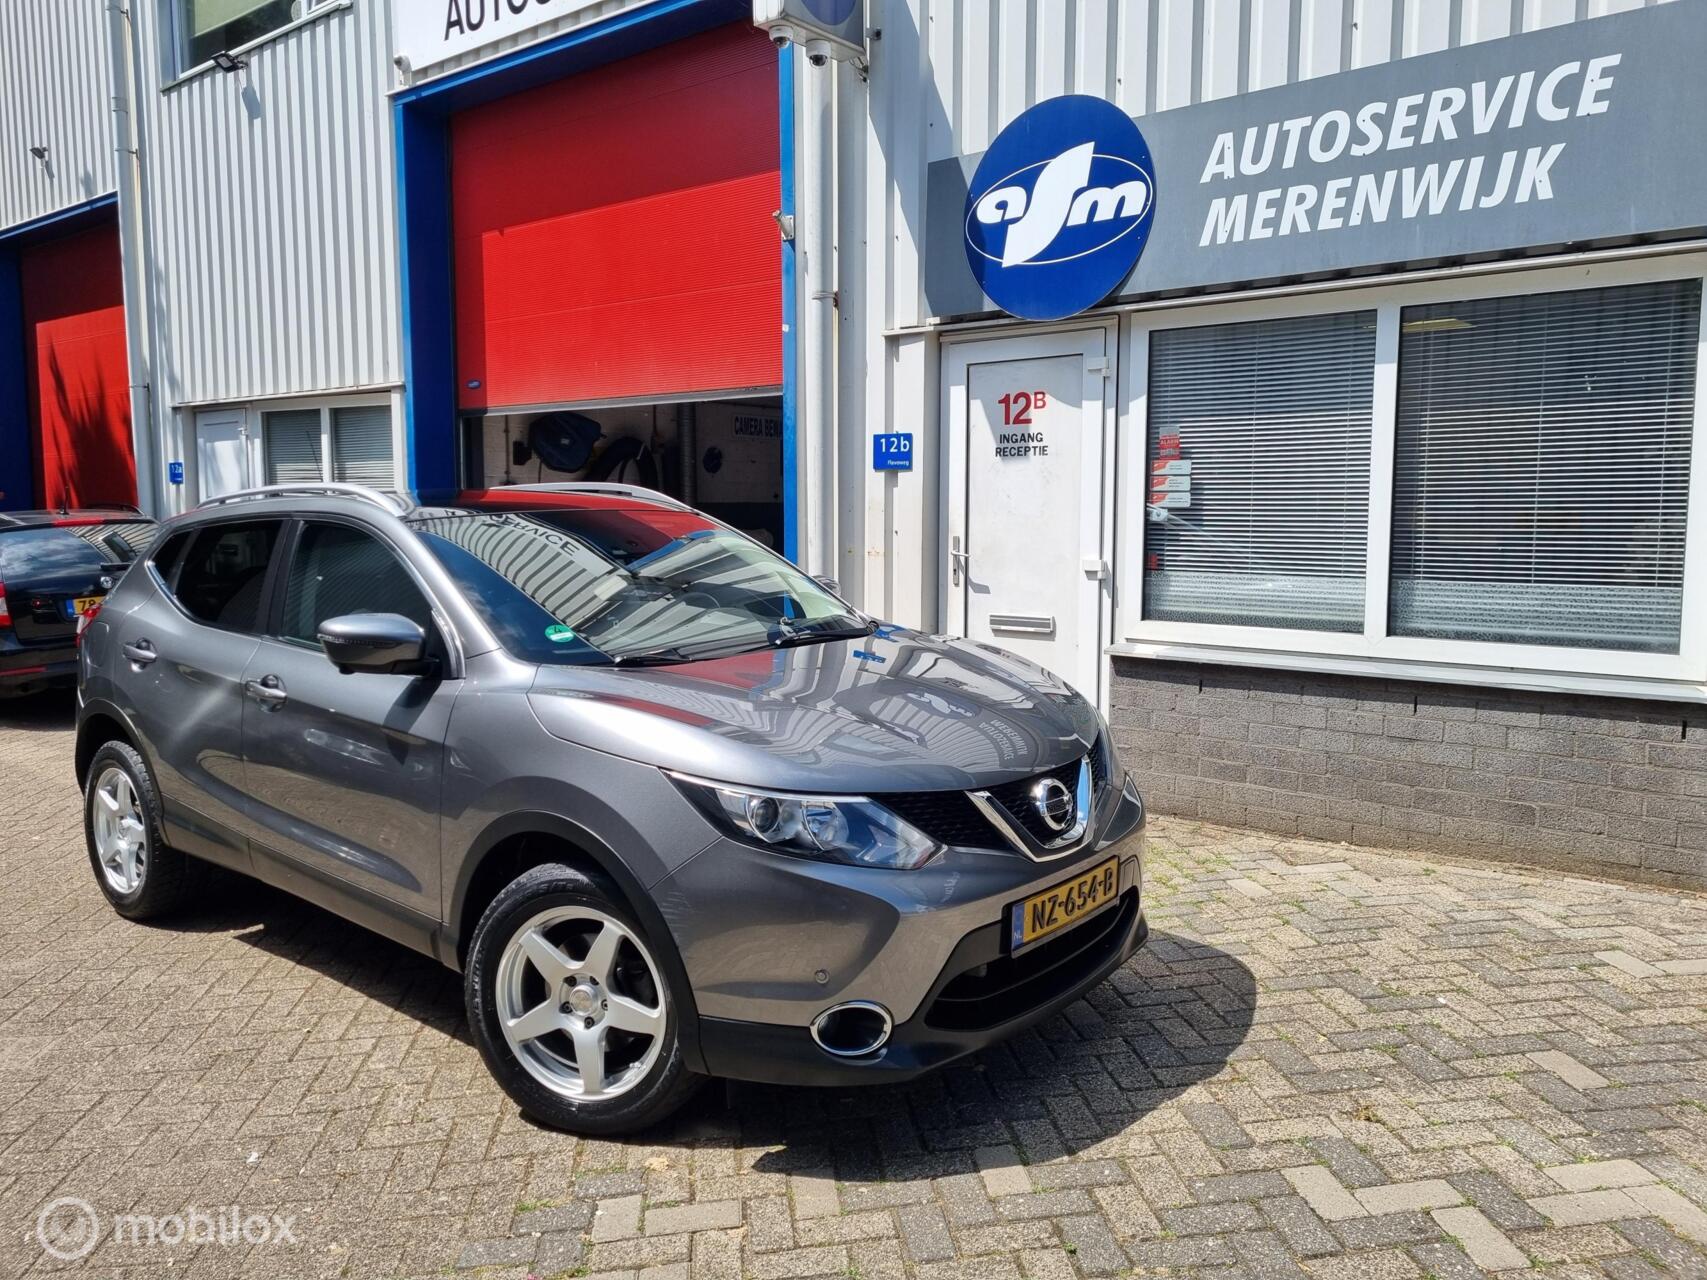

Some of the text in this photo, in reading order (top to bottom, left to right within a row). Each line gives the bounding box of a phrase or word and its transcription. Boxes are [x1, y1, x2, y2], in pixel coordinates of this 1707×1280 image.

[1200, 53, 1622, 184] AUTOSERVICE
[1199, 142, 1567, 247] MERENWIJK
[880, 436, 910, 453] 12b
[995, 445, 1049, 457] RECEPTIE
[999, 431, 1044, 444] INGANG
[1032, 867, 1113, 933] NZ-654-B
